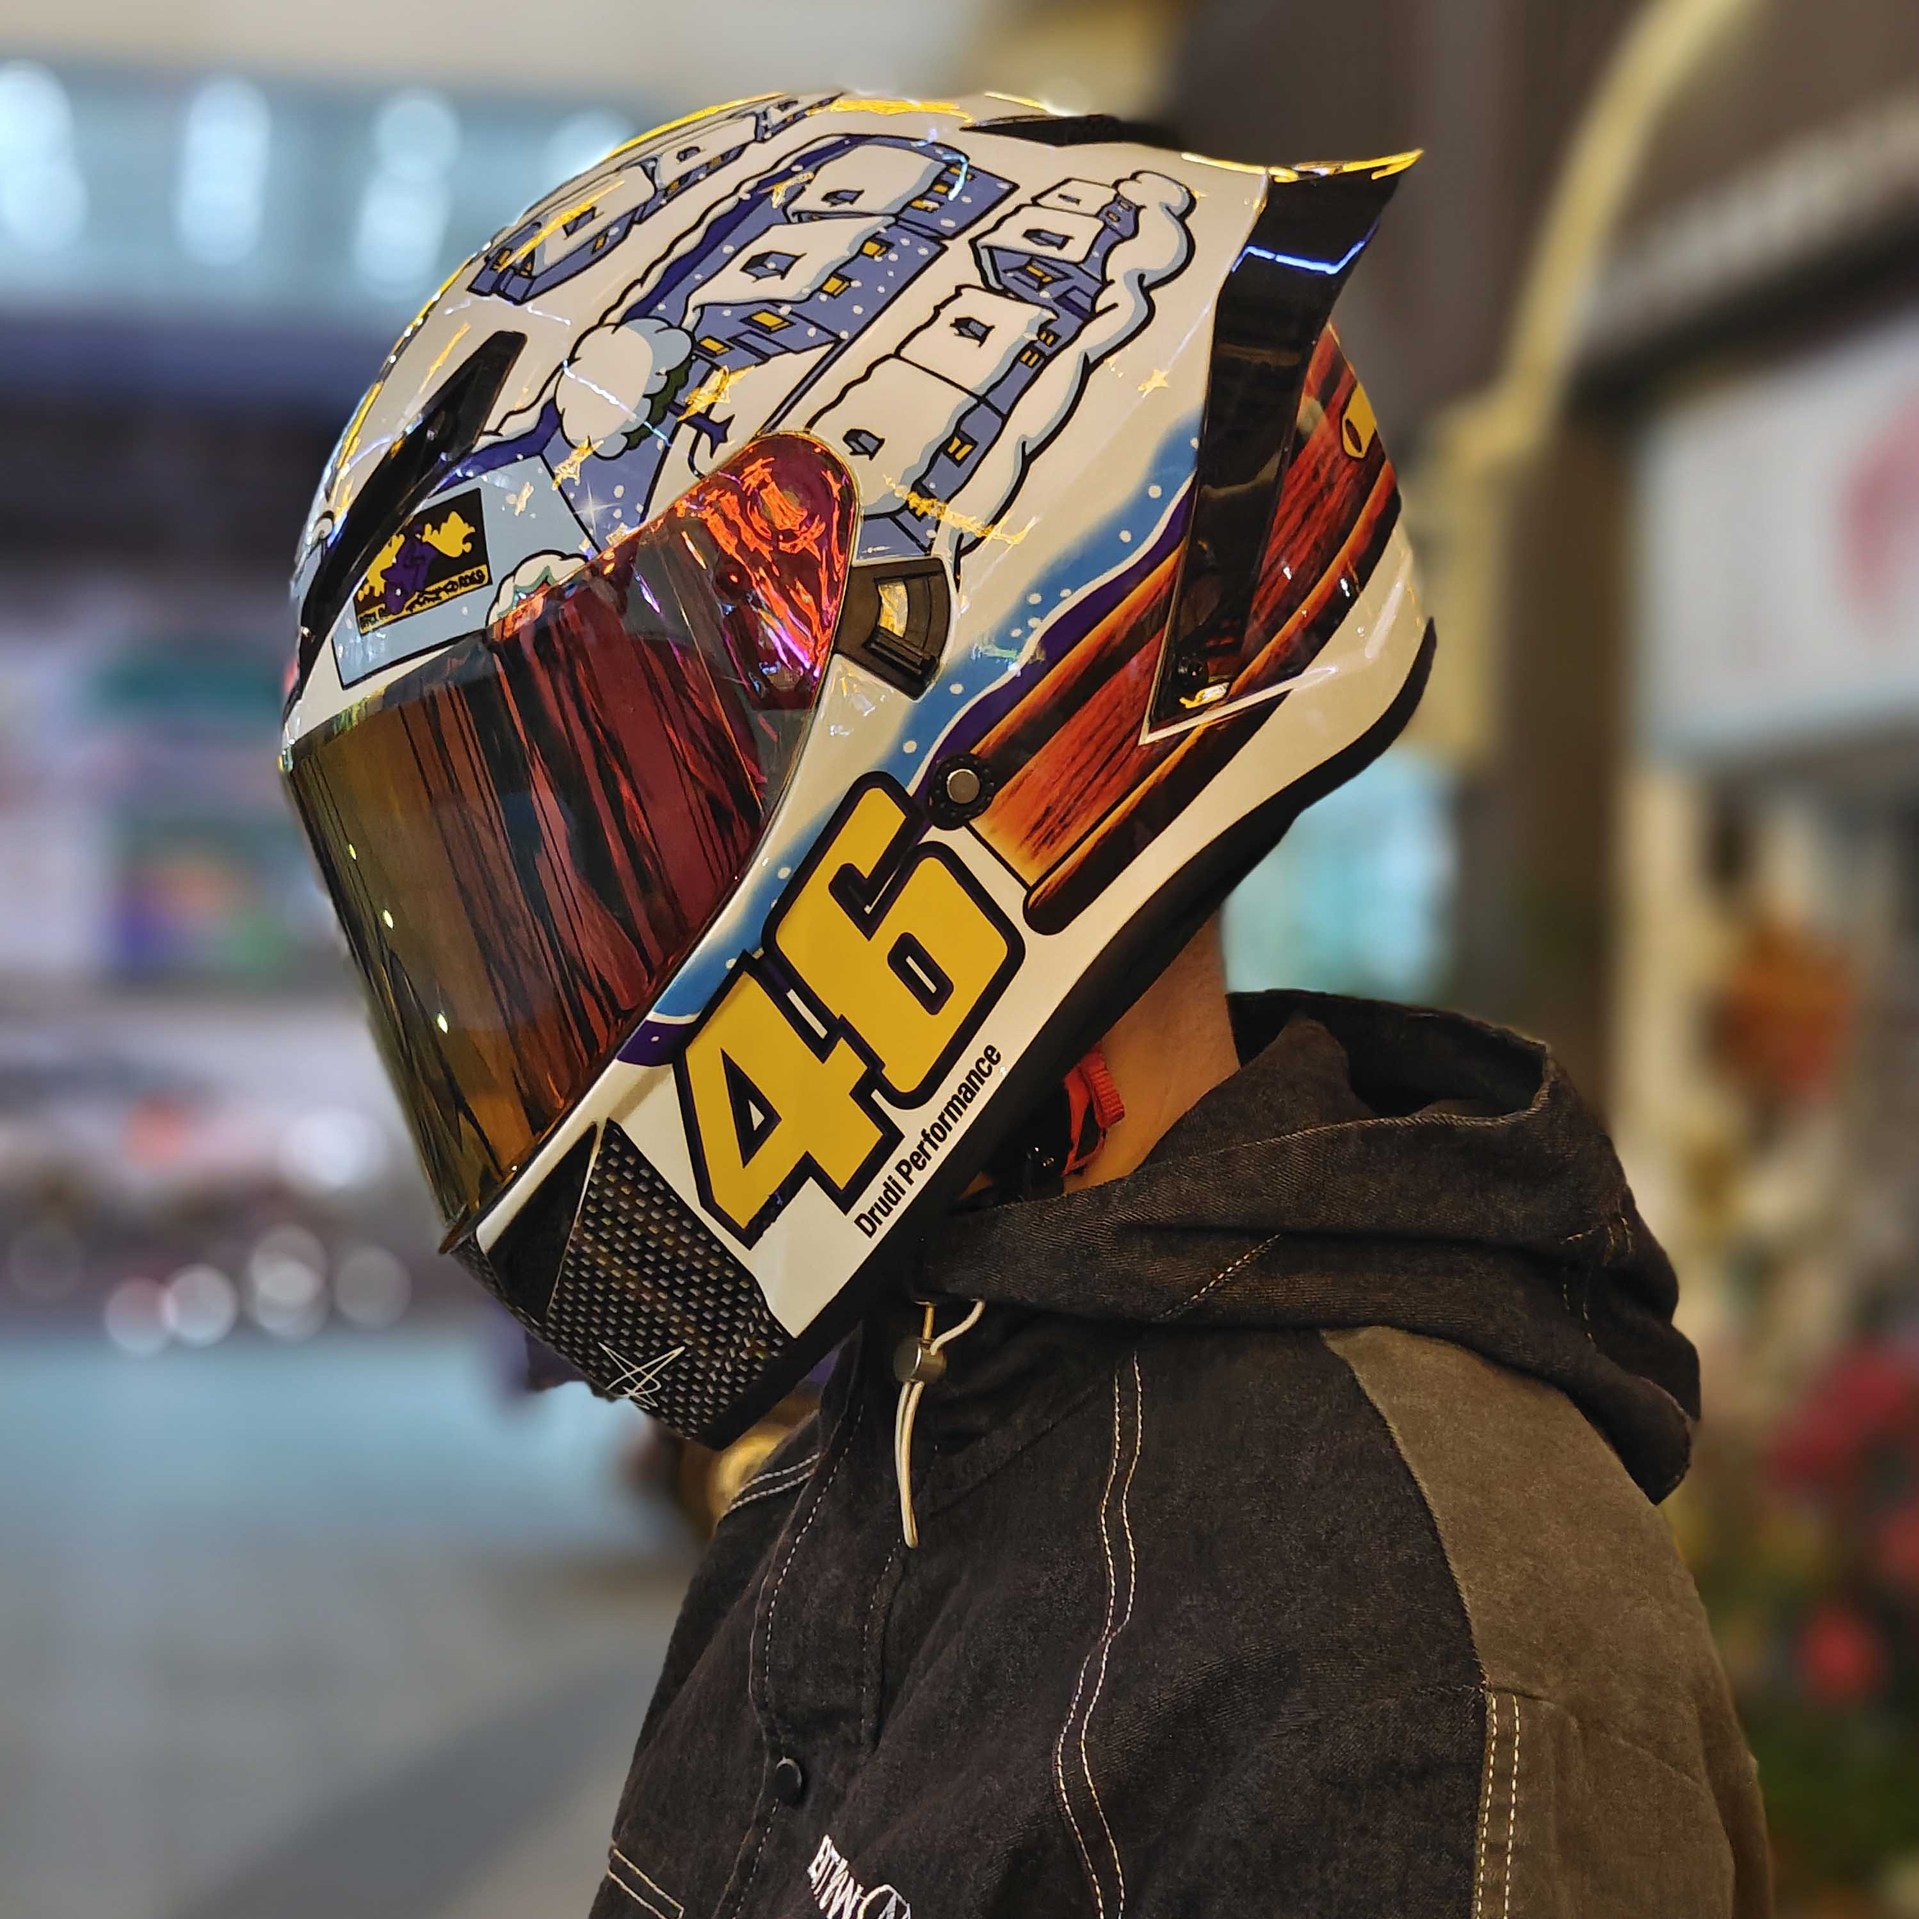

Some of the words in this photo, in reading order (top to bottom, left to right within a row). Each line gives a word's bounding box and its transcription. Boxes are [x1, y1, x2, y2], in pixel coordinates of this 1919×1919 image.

[676, 773, 1023, 1247] 46
[853, 1174, 907, 1239] Drudi
[894, 1044, 1002, 1186] Performance
